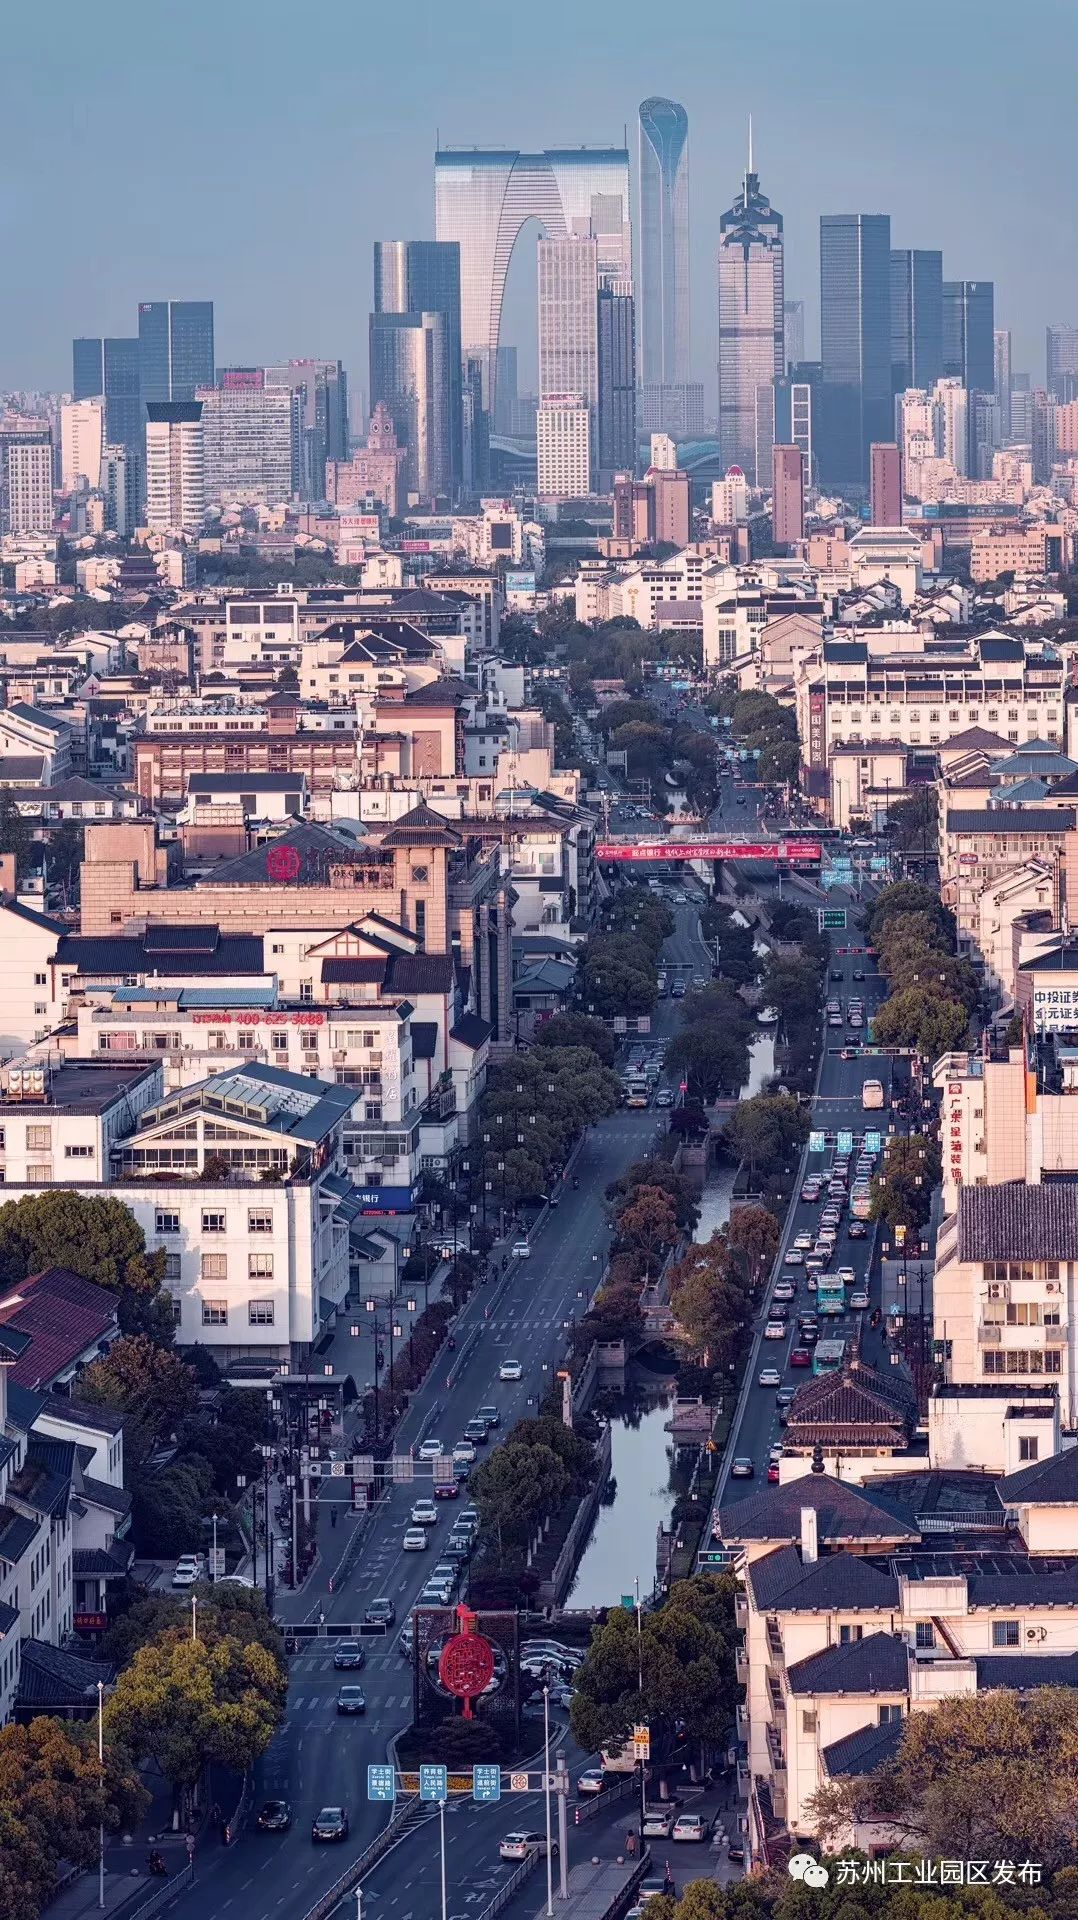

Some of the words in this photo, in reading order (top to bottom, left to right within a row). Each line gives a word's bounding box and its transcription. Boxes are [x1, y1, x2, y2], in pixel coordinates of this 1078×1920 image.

[970, 282, 977, 292] W
[811, 715, 822, 762] 国美电器
[423, 1779, 443, 1787] 人民路
